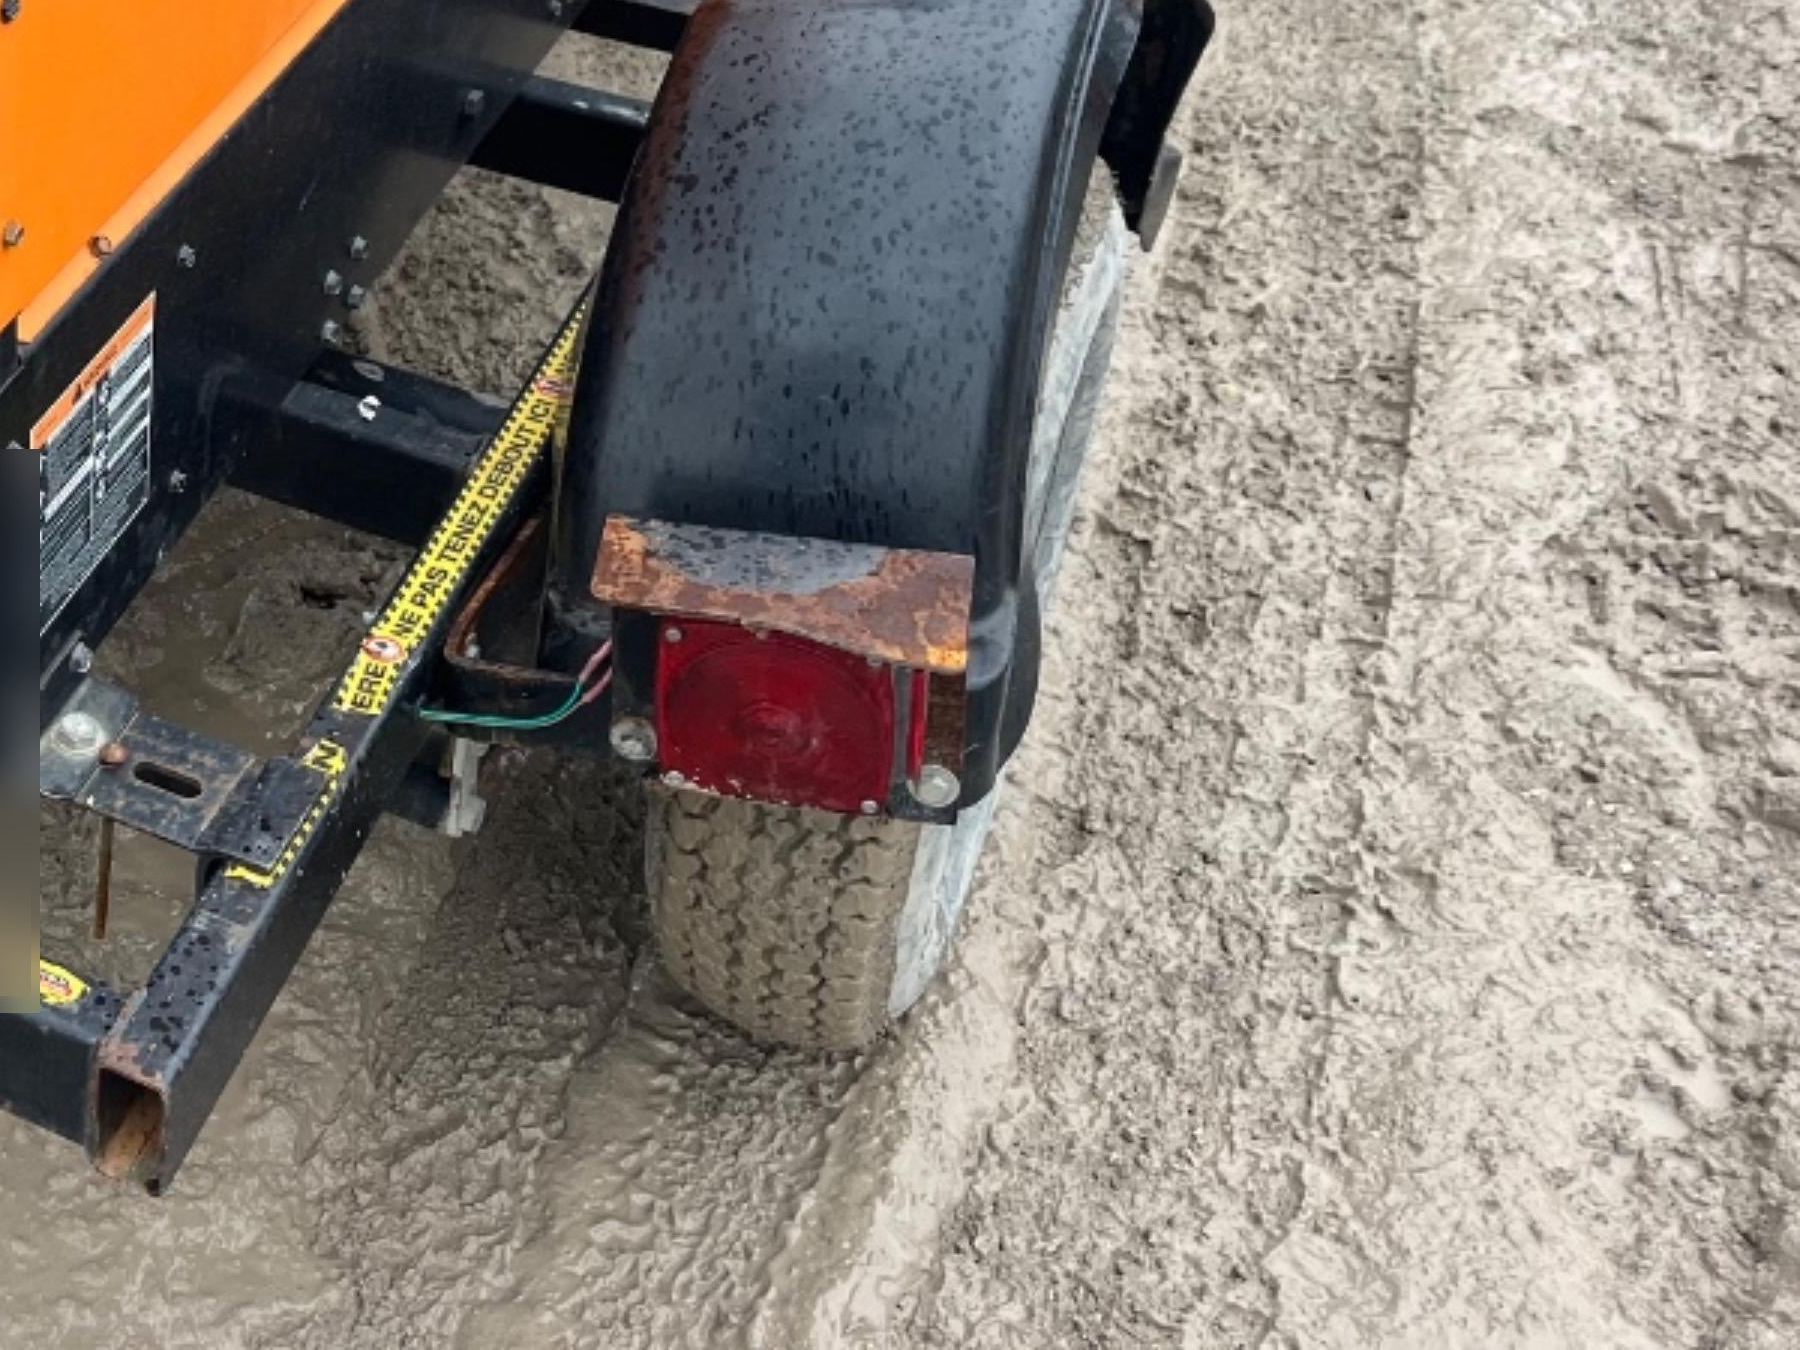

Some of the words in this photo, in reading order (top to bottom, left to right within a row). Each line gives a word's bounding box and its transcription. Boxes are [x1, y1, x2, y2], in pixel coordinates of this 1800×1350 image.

[389, 608, 423, 639] NE
[410, 565, 449, 609] PAS
[435, 499, 490, 563] TENEZ
[478, 422, 538, 500] DEBOUT
